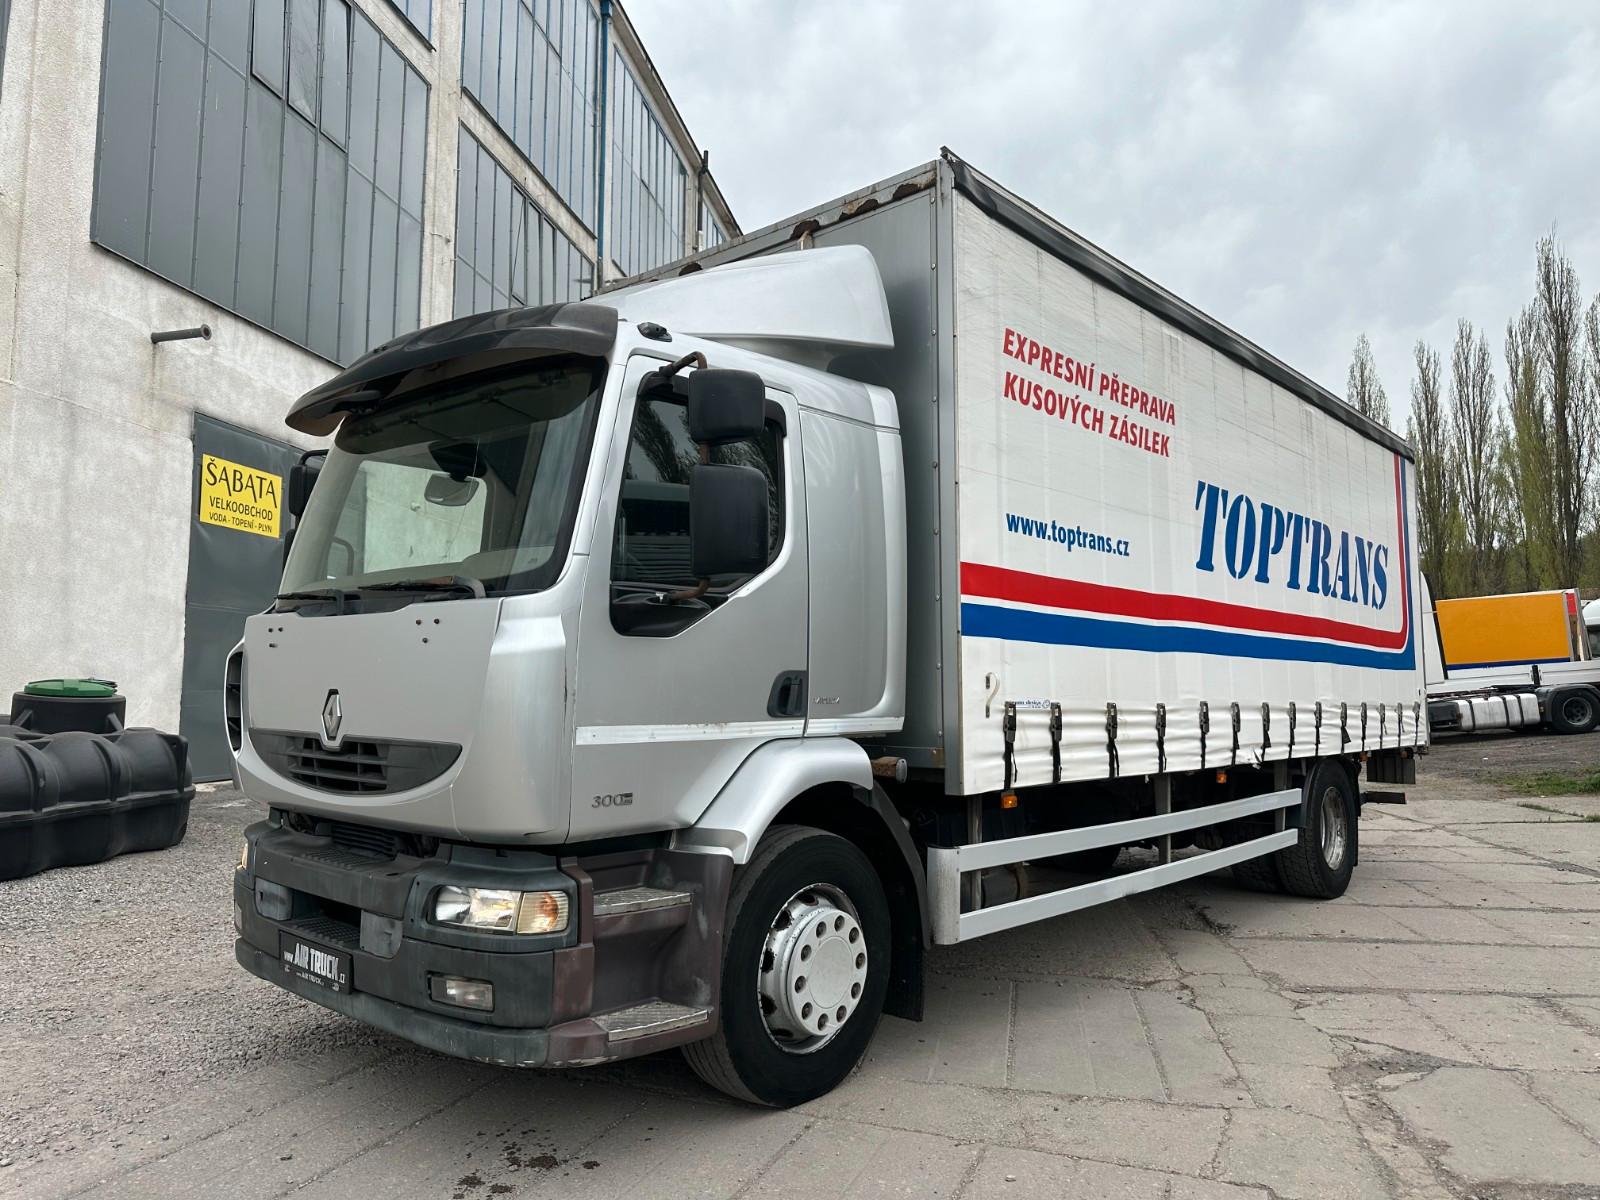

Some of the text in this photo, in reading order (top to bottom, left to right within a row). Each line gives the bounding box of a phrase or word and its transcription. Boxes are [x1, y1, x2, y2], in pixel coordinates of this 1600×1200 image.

[1002, 327, 1176, 426] EXPRESNÍ PŘEPRAVA
[1003, 371, 1170, 457] KUSOVÝCH ZÁSILEK
[205, 458, 277, 509] ŠABATA
[209, 495, 273, 521] VELKOOBCHOD
[209, 511, 272, 533] VODA TOPENÍ PLYN
[1006, 513, 1130, 557] www.toptrans.cz
[1195, 480, 1388, 610] TOPTRANS
[591, 793, 623, 808] 300
[310, 948, 339, 981] TRUCK
